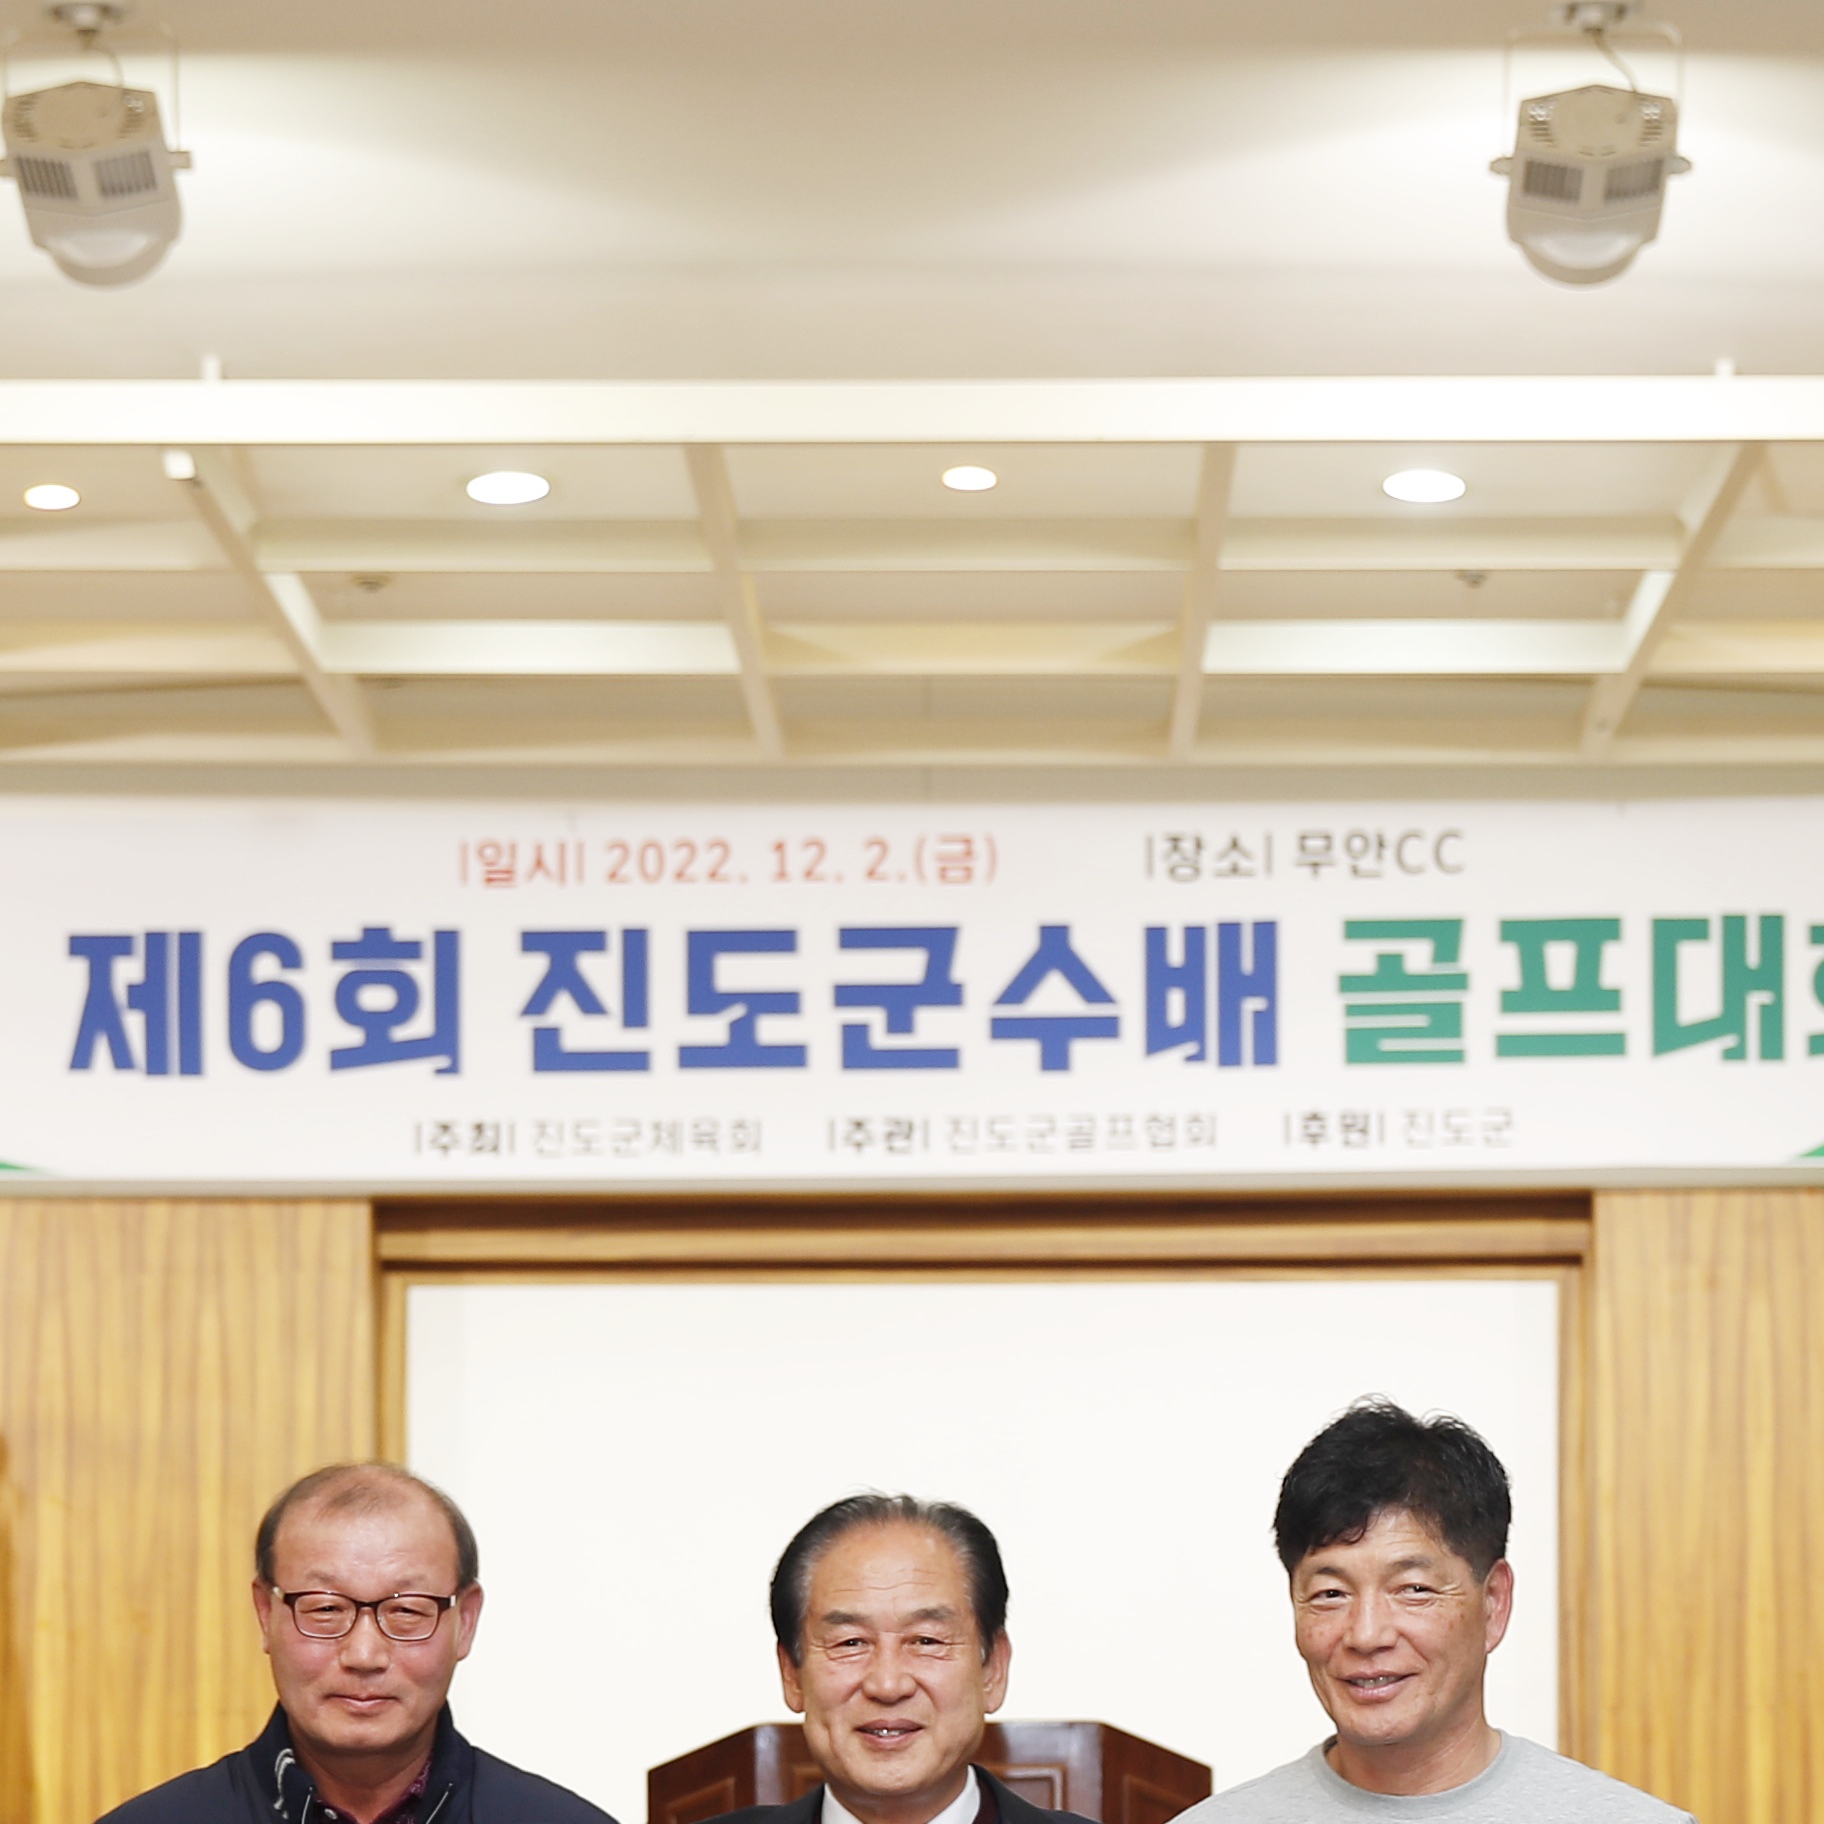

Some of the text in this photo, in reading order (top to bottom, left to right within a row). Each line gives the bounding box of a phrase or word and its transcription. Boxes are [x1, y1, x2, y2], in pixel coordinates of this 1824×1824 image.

[605, 838, 748, 883] 2022.
[771, 837, 842, 882] 12.
[1295, 829, 1463, 879] 무안CC
[68, 927, 461, 1076] 제6회
[519, 920, 1279, 1073] 진도군수배
[533, 1117, 763, 1158] 진도군체육회
[947, 1113, 1217, 1154] 진도군골프협회
[1404, 1106, 1514, 1150] 진도군
